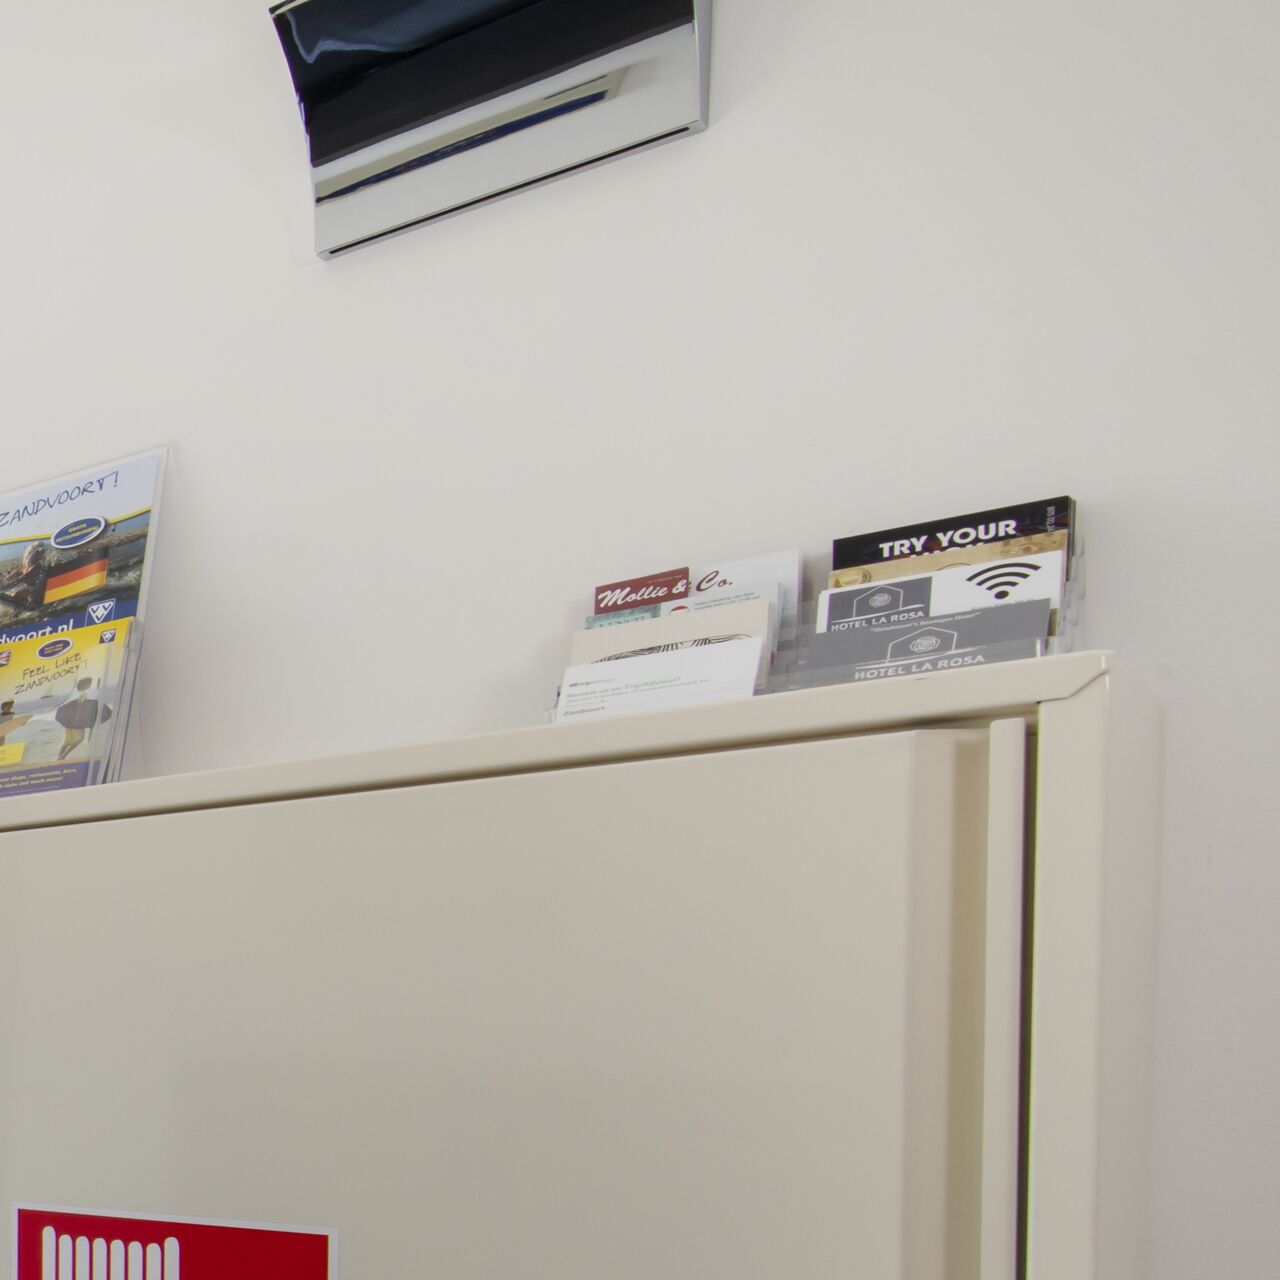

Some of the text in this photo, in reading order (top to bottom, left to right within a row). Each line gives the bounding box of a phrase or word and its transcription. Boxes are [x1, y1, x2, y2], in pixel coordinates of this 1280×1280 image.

[878, 534, 929, 558] TRY
[936, 519, 1018, 548] YOUR
[597, 586, 668, 608] Mollie
[671, 579, 688, 594] &
[695, 570, 734, 593] Co.
[831, 610, 925, 632] HOTEL LA ROSA
[22, 652, 82, 680] FEEL LIKE
[854, 654, 985, 680] HOTEL LA ROSA
